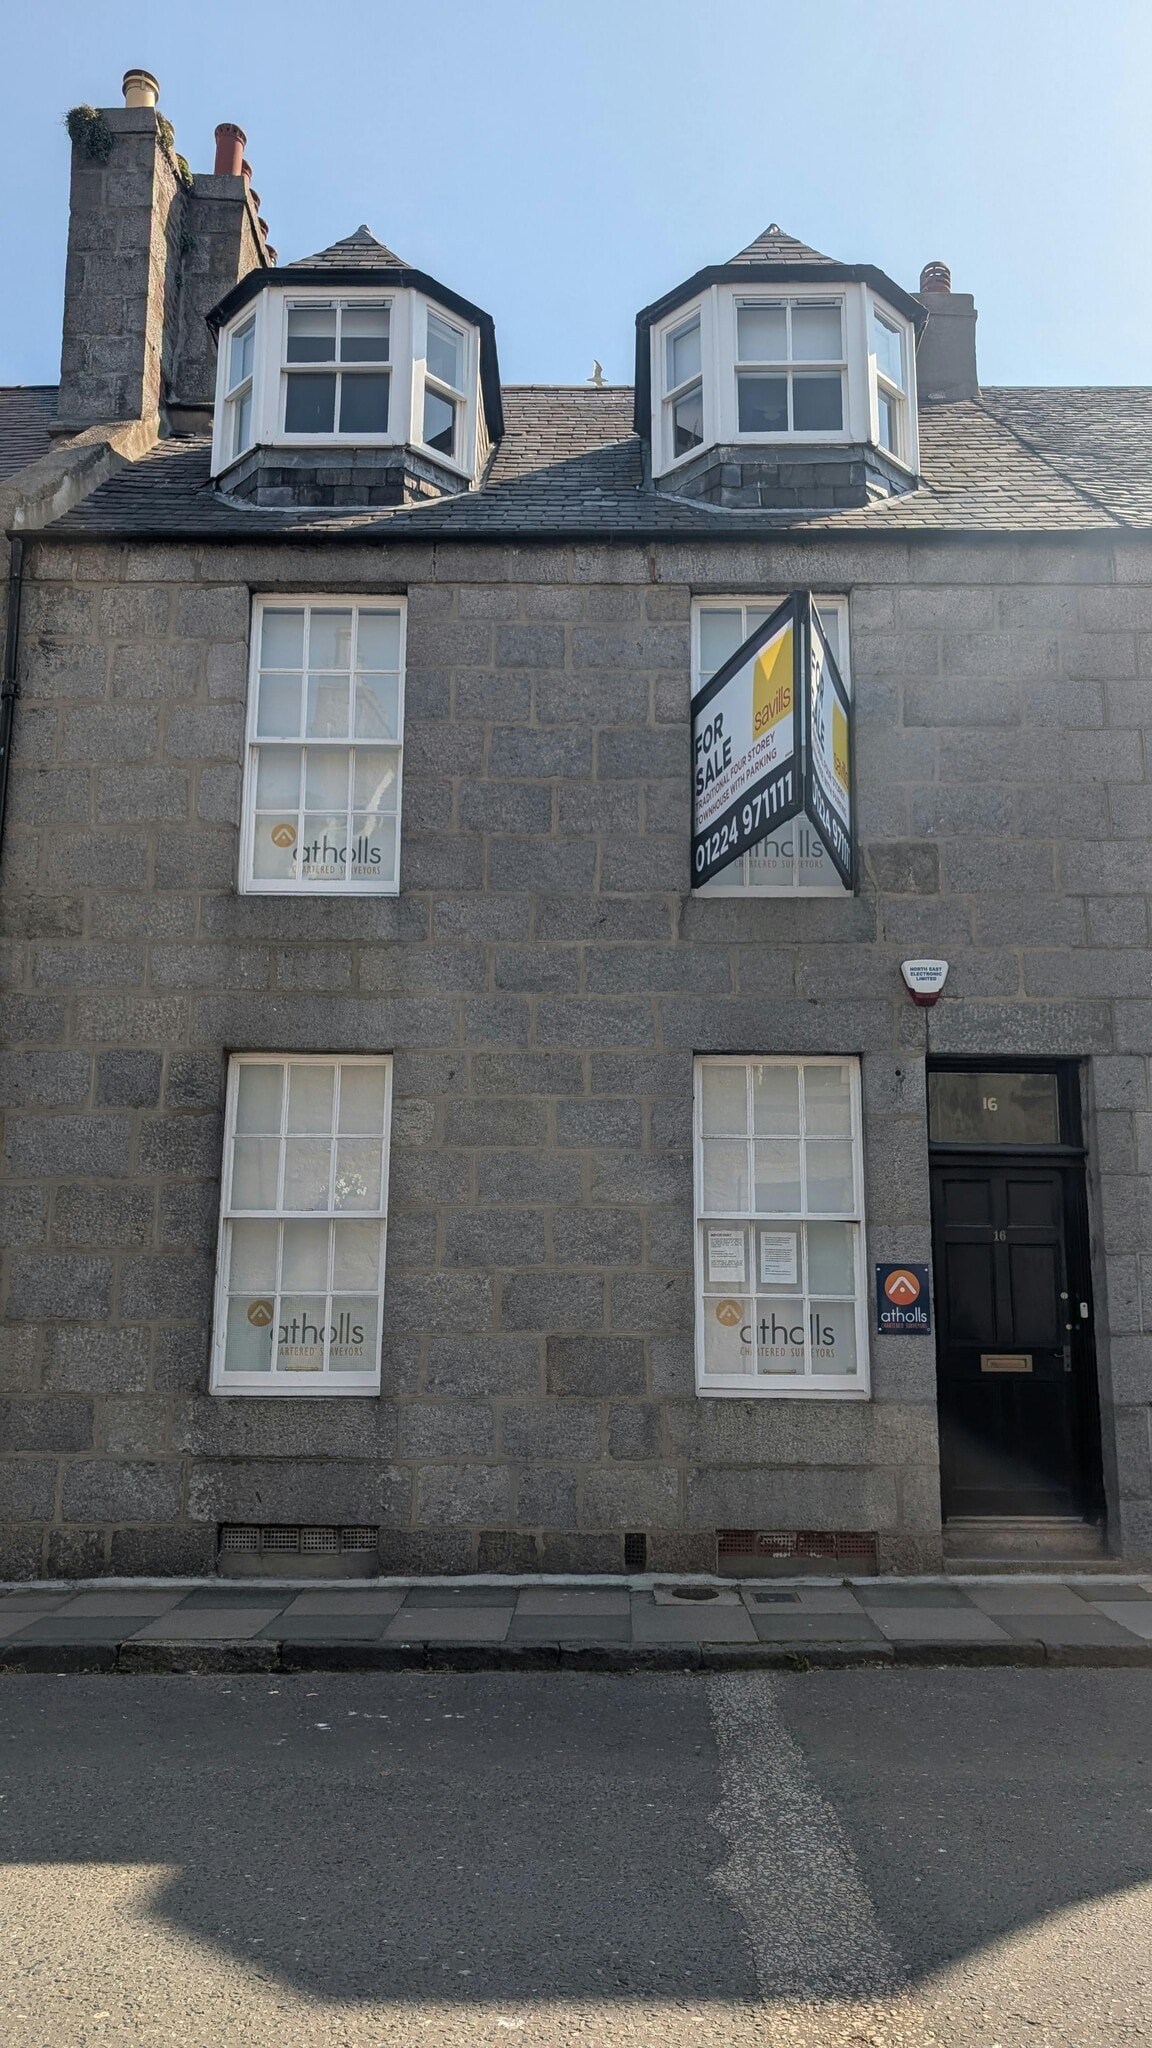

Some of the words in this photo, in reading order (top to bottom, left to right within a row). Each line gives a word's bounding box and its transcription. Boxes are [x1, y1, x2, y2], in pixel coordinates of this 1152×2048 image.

[754, 686, 791, 731] savills
[695, 712, 724, 765] FOR
[695, 736, 732, 797] SALE
[695, 776, 730, 811] TRADITIONAL
[730, 756, 747, 779] FOUR
[747, 731, 776, 762] STOREY
[695, 792, 730, 827] TOWNHOUSE
[730, 776, 745, 795] WITH
[746, 748, 777, 780] PARKING
[695, 816, 739, 873] 01224
[742, 770, 793, 836] 971111
[292, 835, 382, 864] atholls
[740, 830, 824, 858] tholls
[292, 865, 335, 874] CARTERED
[735, 860, 777, 869] CHRTERED
[782, 860, 824, 869] SUREYORS
[982, 1097, 998, 1111] 16
[993, 1230, 1006, 1242] 16
[270, 1312, 364, 1344] atholls
[881, 1306, 928, 1323] atholls
[740, 1313, 835, 1346] atholls
[270, 1347, 315, 1356] CARTERED
[320, 1347, 363, 1356] SRVEYORS
[740, 1347, 786, 1357] CHRTERED
[791, 1348, 835, 1358] SUREYORS
